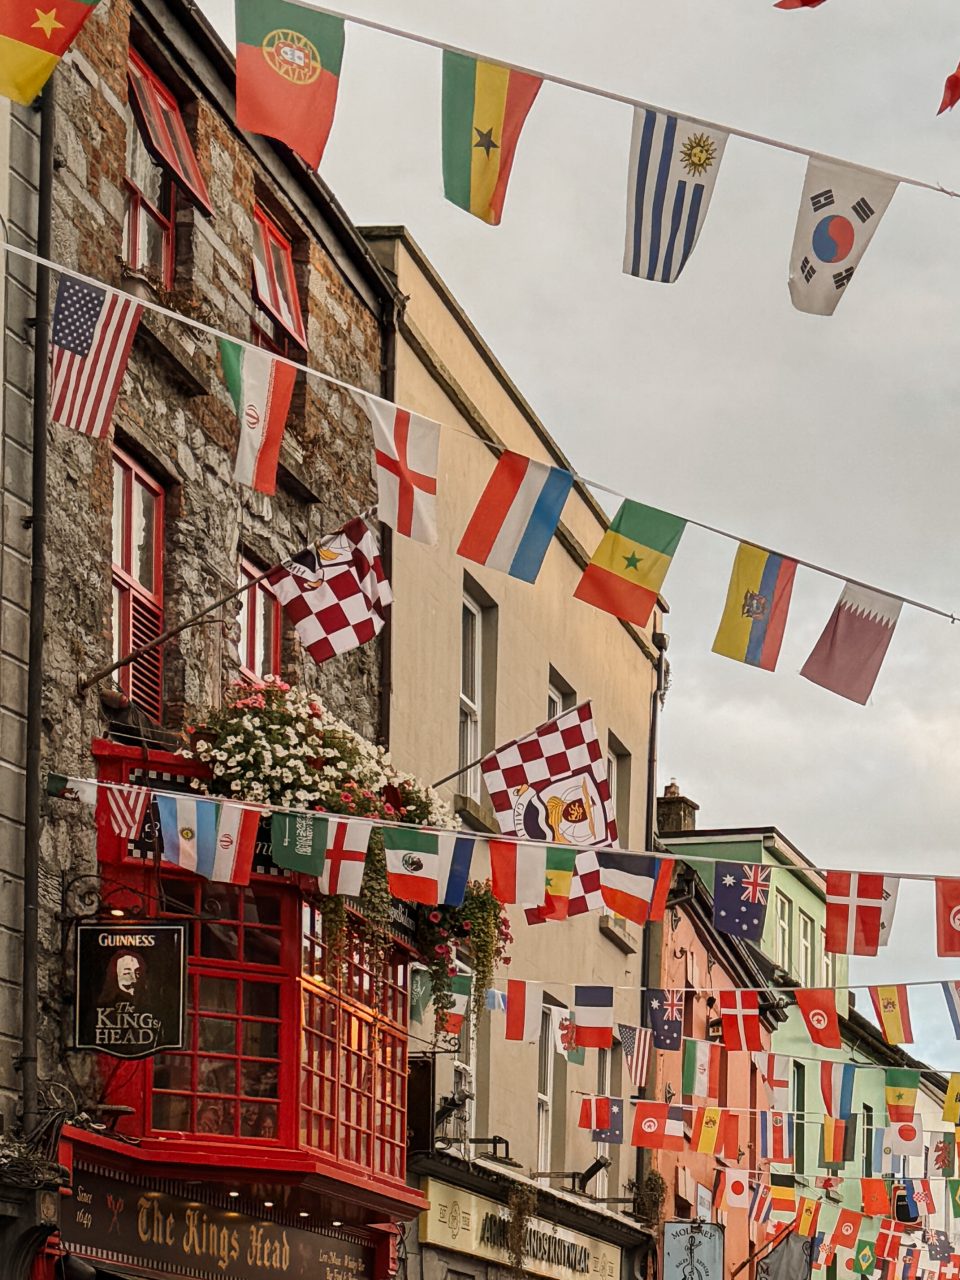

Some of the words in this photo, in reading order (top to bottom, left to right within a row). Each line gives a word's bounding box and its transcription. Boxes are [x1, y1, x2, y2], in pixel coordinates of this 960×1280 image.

[98, 933, 155, 946] GUINNESS
[115, 1002, 135, 1013] The
[95, 1028, 154, 1044] HEAD
[137, 1197, 175, 1246] The
[183, 1208, 240, 1270] Kings
[247, 1224, 290, 1271] Head
[671, 1227, 716, 1240] MOLNEY
